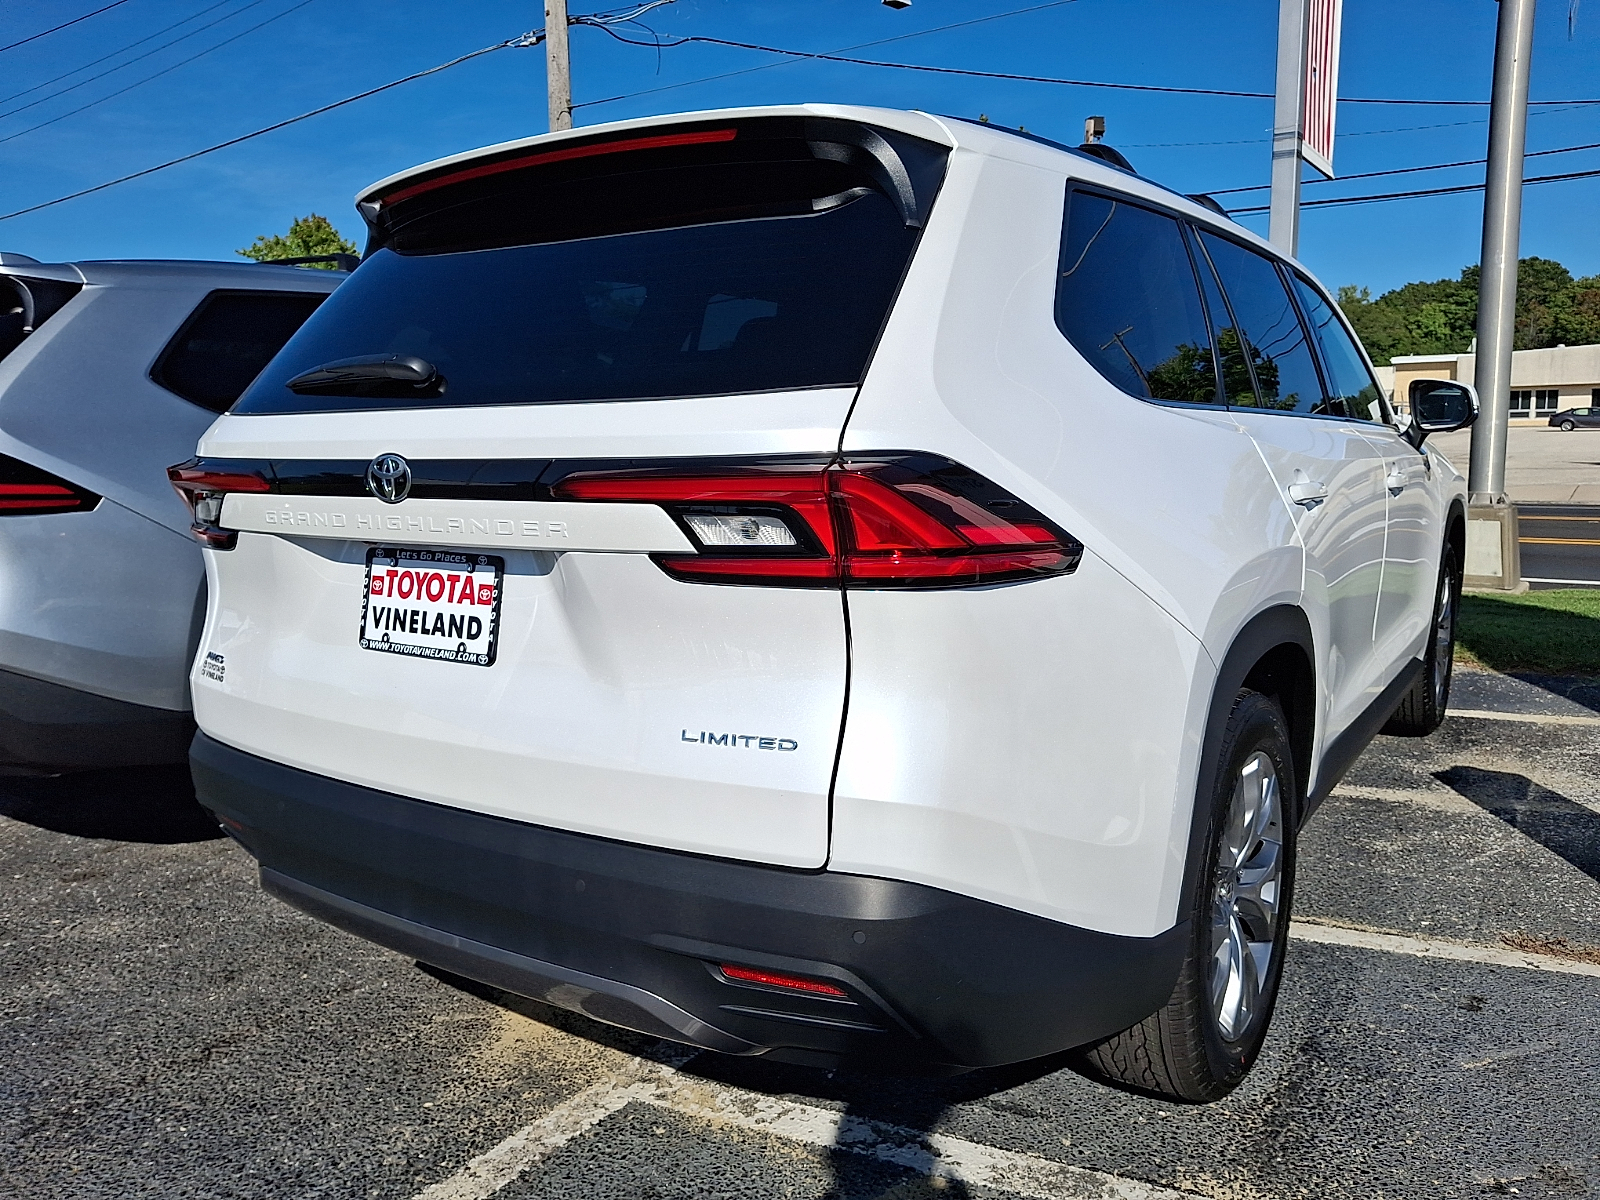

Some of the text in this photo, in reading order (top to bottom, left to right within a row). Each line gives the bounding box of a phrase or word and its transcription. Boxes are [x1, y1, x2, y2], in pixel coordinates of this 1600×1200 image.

[265, 510, 569, 538] GRAND HIGHLANDER
[396, 550, 467, 563] Let's Go Places
[386, 569, 475, 605] TOYOTA
[372, 605, 482, 640] VINELAND
[369, 640, 477, 663] WWW.TOYOTAVINELAND.COM
[681, 729, 798, 751] LIMITED
